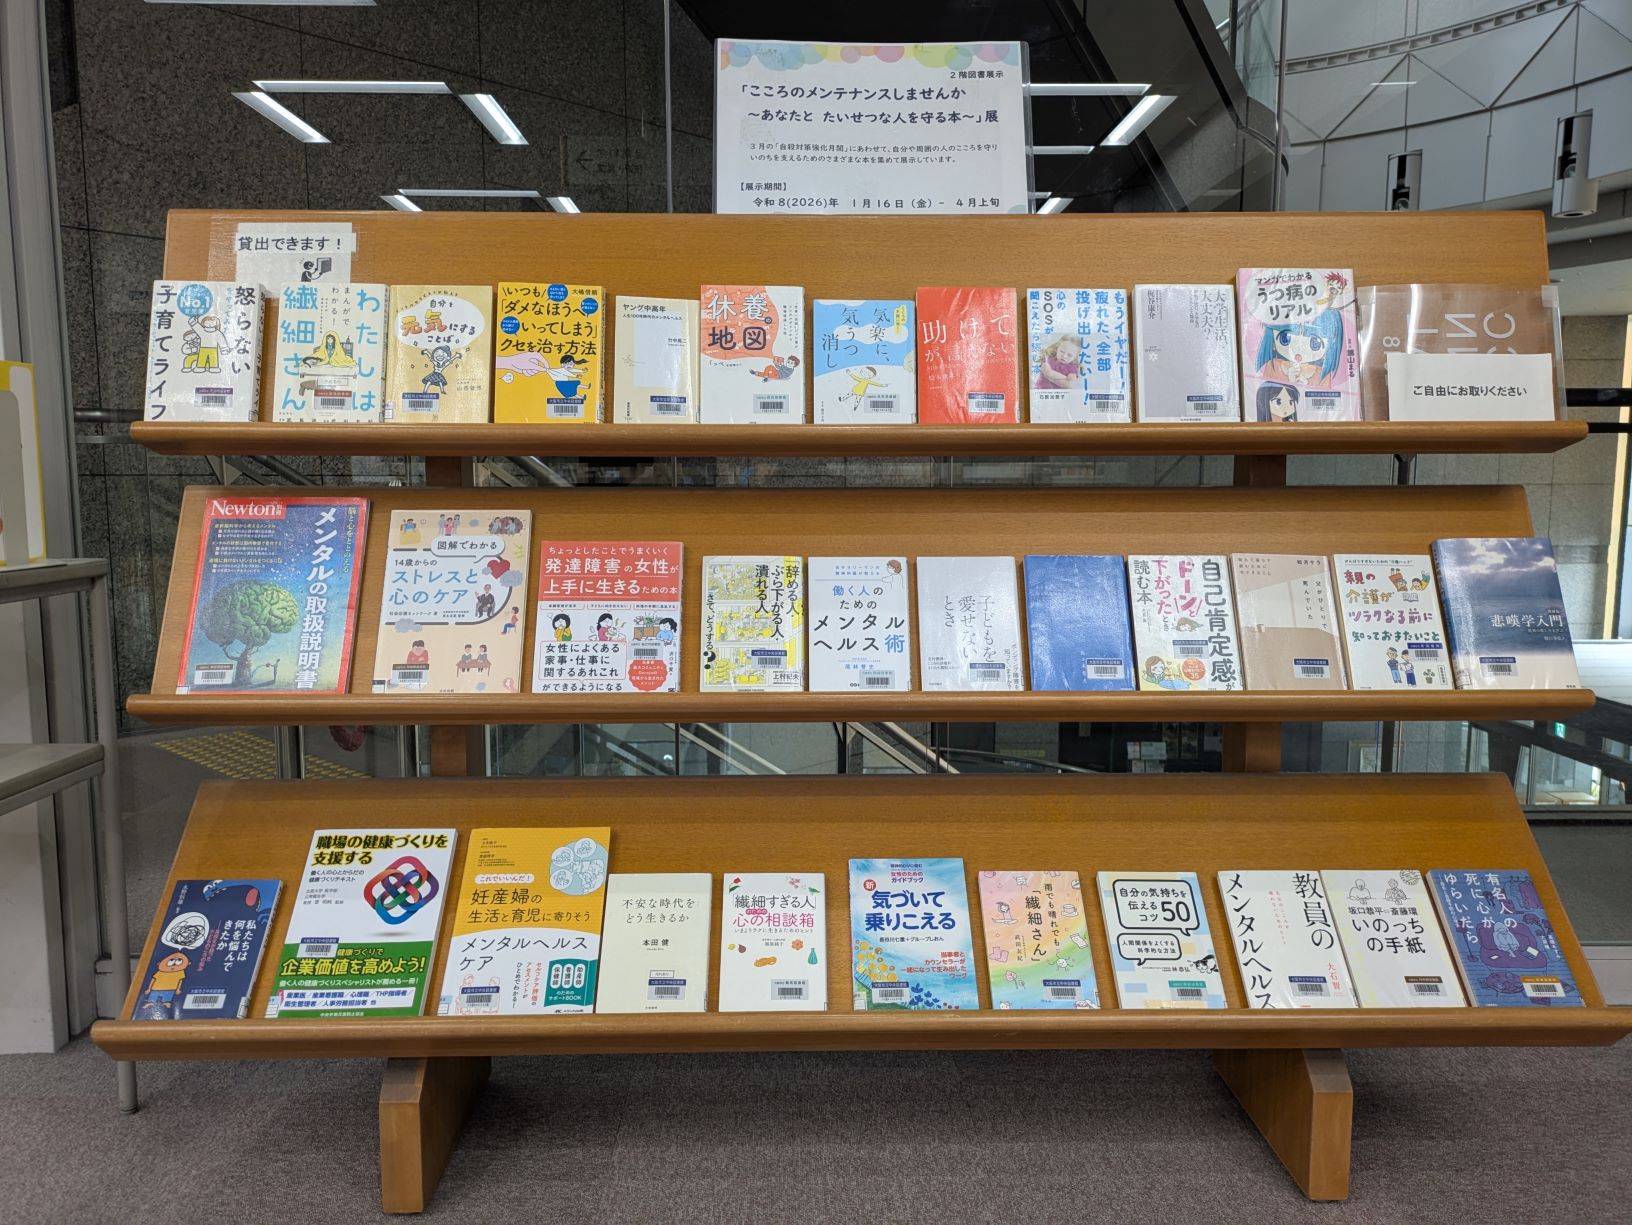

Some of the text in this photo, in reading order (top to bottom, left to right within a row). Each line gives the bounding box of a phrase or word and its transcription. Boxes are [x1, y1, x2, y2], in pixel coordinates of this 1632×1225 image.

[950, 70, 1004, 80] 2階図書展示
[741, 84, 966, 101] 「こころのメンテナンスしませんか
[740, 181, 788, 192] 【展示期間】
[238, 236, 341, 252] 貸出できます！
[1255, 272, 1313, 285] マンガでわかる
[507, 286, 541, 298] いつも
[1056, 291, 1066, 310] 心の
[1257, 284, 1318, 302] うつ病の
[179, 293, 210, 309] No.1
[342, 287, 351, 328] まんがで
[501, 299, 586, 317] 「ダメなほうへ
[623, 303, 666, 313] ヤング中高年
[1043, 291, 1054, 335] SOSが
[1268, 303, 1312, 321] リアル
[232, 285, 256, 375] 怒らない
[400, 309, 476, 336] 元気にする
[521, 321, 598, 338] いってしまう」
[921, 314, 1010, 344] 助けて
[427, 335, 453, 344] ことば
[708, 326, 766, 351] 地図
[841, 307, 859, 357] 気うつ
[870, 307, 891, 362] 気楽に、
[1094, 291, 1111, 373] 疲れた、全部
[151, 284, 177, 421] 子育てライフ
[280, 287, 318, 411] 繊細さん
[352, 289, 380, 411] わたしは
[500, 338, 597, 355] クセを治す方法
[822, 333, 839, 368] 消し
[1412, 384, 1527, 397] ご自由にお取りください
[210, 500, 277, 516] Newton
[437, 541, 498, 551] 図解でわかる
[548, 546, 668, 555] ちょっとしたことでうまくいく
[394, 559, 438, 567] 14歳からの
[545, 558, 679, 574] 発達障害の女性が
[392, 568, 478, 585] ストレスと
[1133, 559, 1153, 605] 読む本
[1343, 569, 1375, 585] 親の
[544, 579, 678, 596] 上手に生きるための本
[832, 585, 883, 597] 働く人の
[1151, 559, 1172, 632] 下がったとき
[295, 507, 338, 688] メンタルの取扱説明書
[388, 588, 469, 605] 心のケア
[840, 600, 877, 610] ための
[1315, 580, 1328, 630] 父がひとりで
[1345, 588, 1395, 605] 介護が
[944, 595, 955, 628] とき
[1348, 607, 1433, 624] ツラクなる前に
[814, 613, 905, 631] メンタル
[958, 595, 978, 659] 愛せない
[978, 595, 997, 663] 子どもを
[1202, 559, 1237, 692] 自己肯定感が
[1490, 614, 1563, 628] 悲嘆学入門
[814, 634, 905, 653] ヘルス術
[1351, 631, 1440, 643] 知っておきたいこと
[545, 643, 620, 654] 女性によくある
[545, 655, 610, 665] 家事・仕事に
[544, 667, 618, 678] 関するあれこれ
[542, 682, 623, 692] ができるようになる
[316, 835, 448, 850] 職場の健康づくりを
[312, 851, 373, 866] 支援する
[480, 874, 531, 883] これでいいんだ！
[891, 877, 924, 885] ガイドブック
[470, 888, 542, 906] 妊産婦の
[732, 893, 817, 910] 「繊細すぎる人」
[871, 890, 946, 910] 気づいて
[1119, 887, 1187, 900] 自分の気持ちを
[1464, 872, 1496, 928] 死に心が
[1485, 872, 1518, 929] 有名人の
[623, 898, 695, 909] 不安な時代を
[1128, 901, 1157, 912] 伝える
[1291, 872, 1334, 950] 教員の
[1444, 872, 1479, 945] ゆらいだら
[467, 908, 591, 924] 生活と育児に寄りそう
[626, 913, 689, 924] どう生きるか
[733, 913, 814, 928] 心の相談箱
[1044, 884, 1060, 948] 雨でも晴れでも
[1139, 901, 1190, 924] コツ 50
[865, 912, 956, 932] 乗りこえる
[1025, 890, 1047, 965] 「繊細さん」
[1352, 918, 1424, 935] いのっち
[215, 919, 236, 951] きたか
[237, 919, 257, 961] 私たちは
[1226, 872, 1276, 1009] メンタルヘルス
[223, 919, 246, 972] 何を悩んで
[337, 948, 384, 956] 健康づくりで
[461, 935, 588, 953] メンタルヘルス
[1122, 940, 1175, 948] 人間関係をよくする
[1137, 947, 1176, 955] 科学的な方法
[1366, 936, 1426, 956] の手紙
[280, 957, 425, 977] 企業価値を高めよう！
[459, 955, 494, 972] ケア
[924, 958, 966, 966] カウンセラーが
